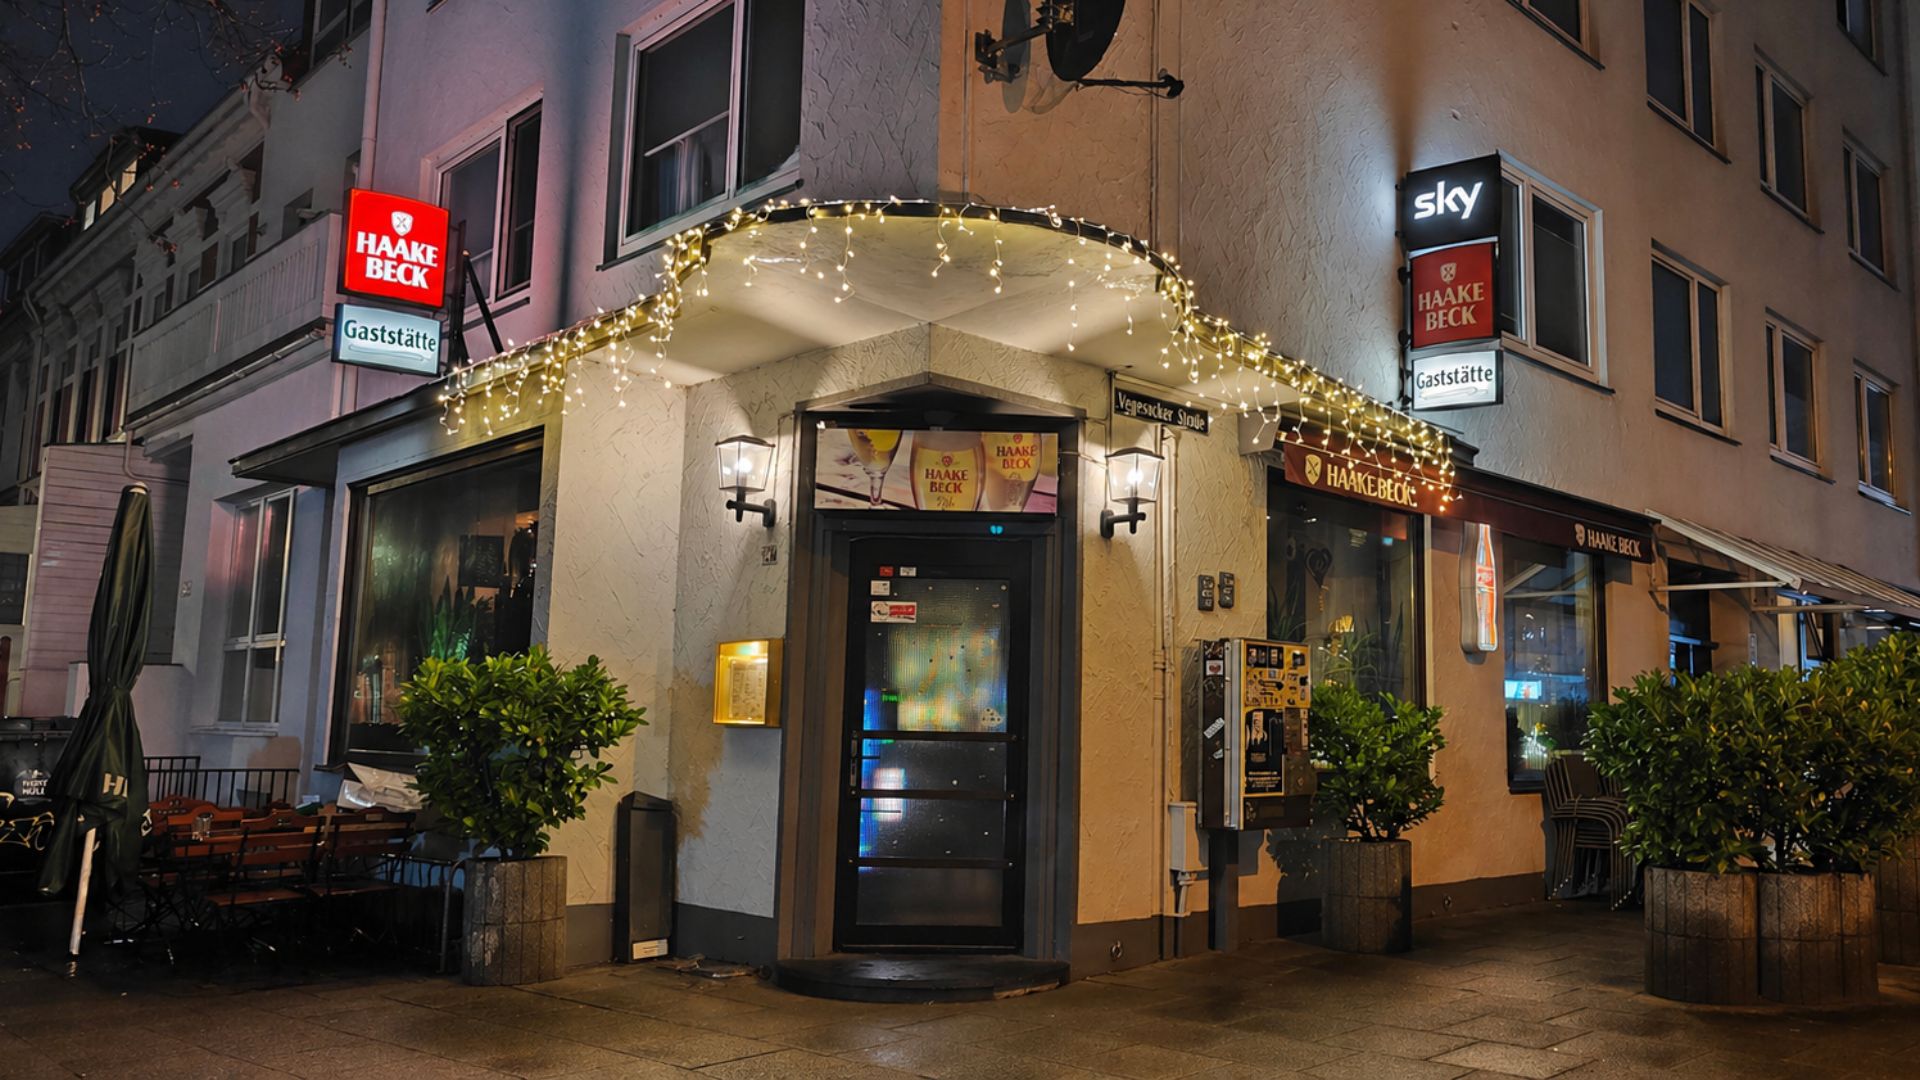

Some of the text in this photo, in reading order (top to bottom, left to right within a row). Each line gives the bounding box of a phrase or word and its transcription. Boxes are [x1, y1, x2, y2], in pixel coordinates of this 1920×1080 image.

[1413, 180, 1483, 220] sky
[356, 231, 439, 267] HAAKE
[365, 256, 429, 290] BECK
[1418, 282, 1485, 312] HAAKE
[1425, 305, 1477, 332] BECK
[344, 319, 436, 352] Gaststätte
[1416, 365, 1494, 390] Gaststätte
[996, 444, 1038, 458] HAAKE
[1002, 457, 1032, 470] BECK
[925, 468, 969, 481] HAAKE
[929, 481, 963, 494] BECK
[1587, 528, 1642, 559] HAAKE BECK
